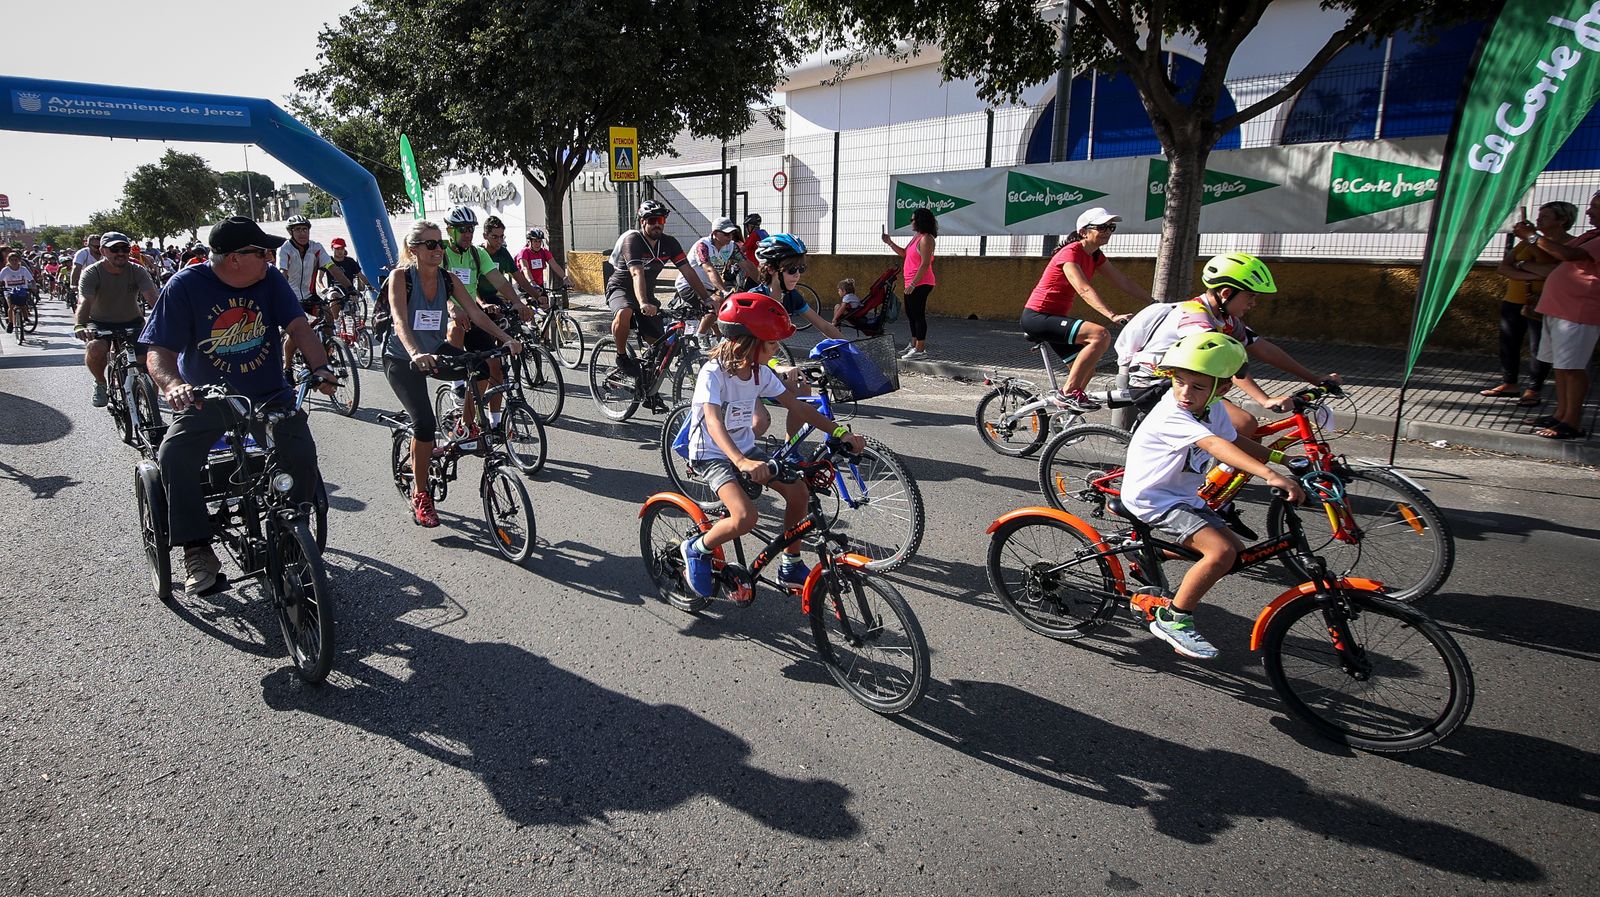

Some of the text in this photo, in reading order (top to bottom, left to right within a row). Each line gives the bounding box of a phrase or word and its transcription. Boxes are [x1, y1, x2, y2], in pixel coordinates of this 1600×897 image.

[1495, 45, 1582, 137] Corte
[48, 96, 244, 117] Ayuntamiento de Jerez
[48, 105, 111, 116] Deportes
[613, 171, 635, 180] PEATONES
[1149, 181, 1163, 194] El
[1202, 180, 1246, 197] nglés
[1332, 173, 1439, 198] El Corte Ingl
[905, 198, 925, 209] Corte
[1008, 190, 1019, 203] El
[1019, 190, 1044, 202] Corte
[211, 304, 225, 316] EL
[197, 310, 270, 354] Abuelo
[213, 346, 271, 374] DEL MUNDO
